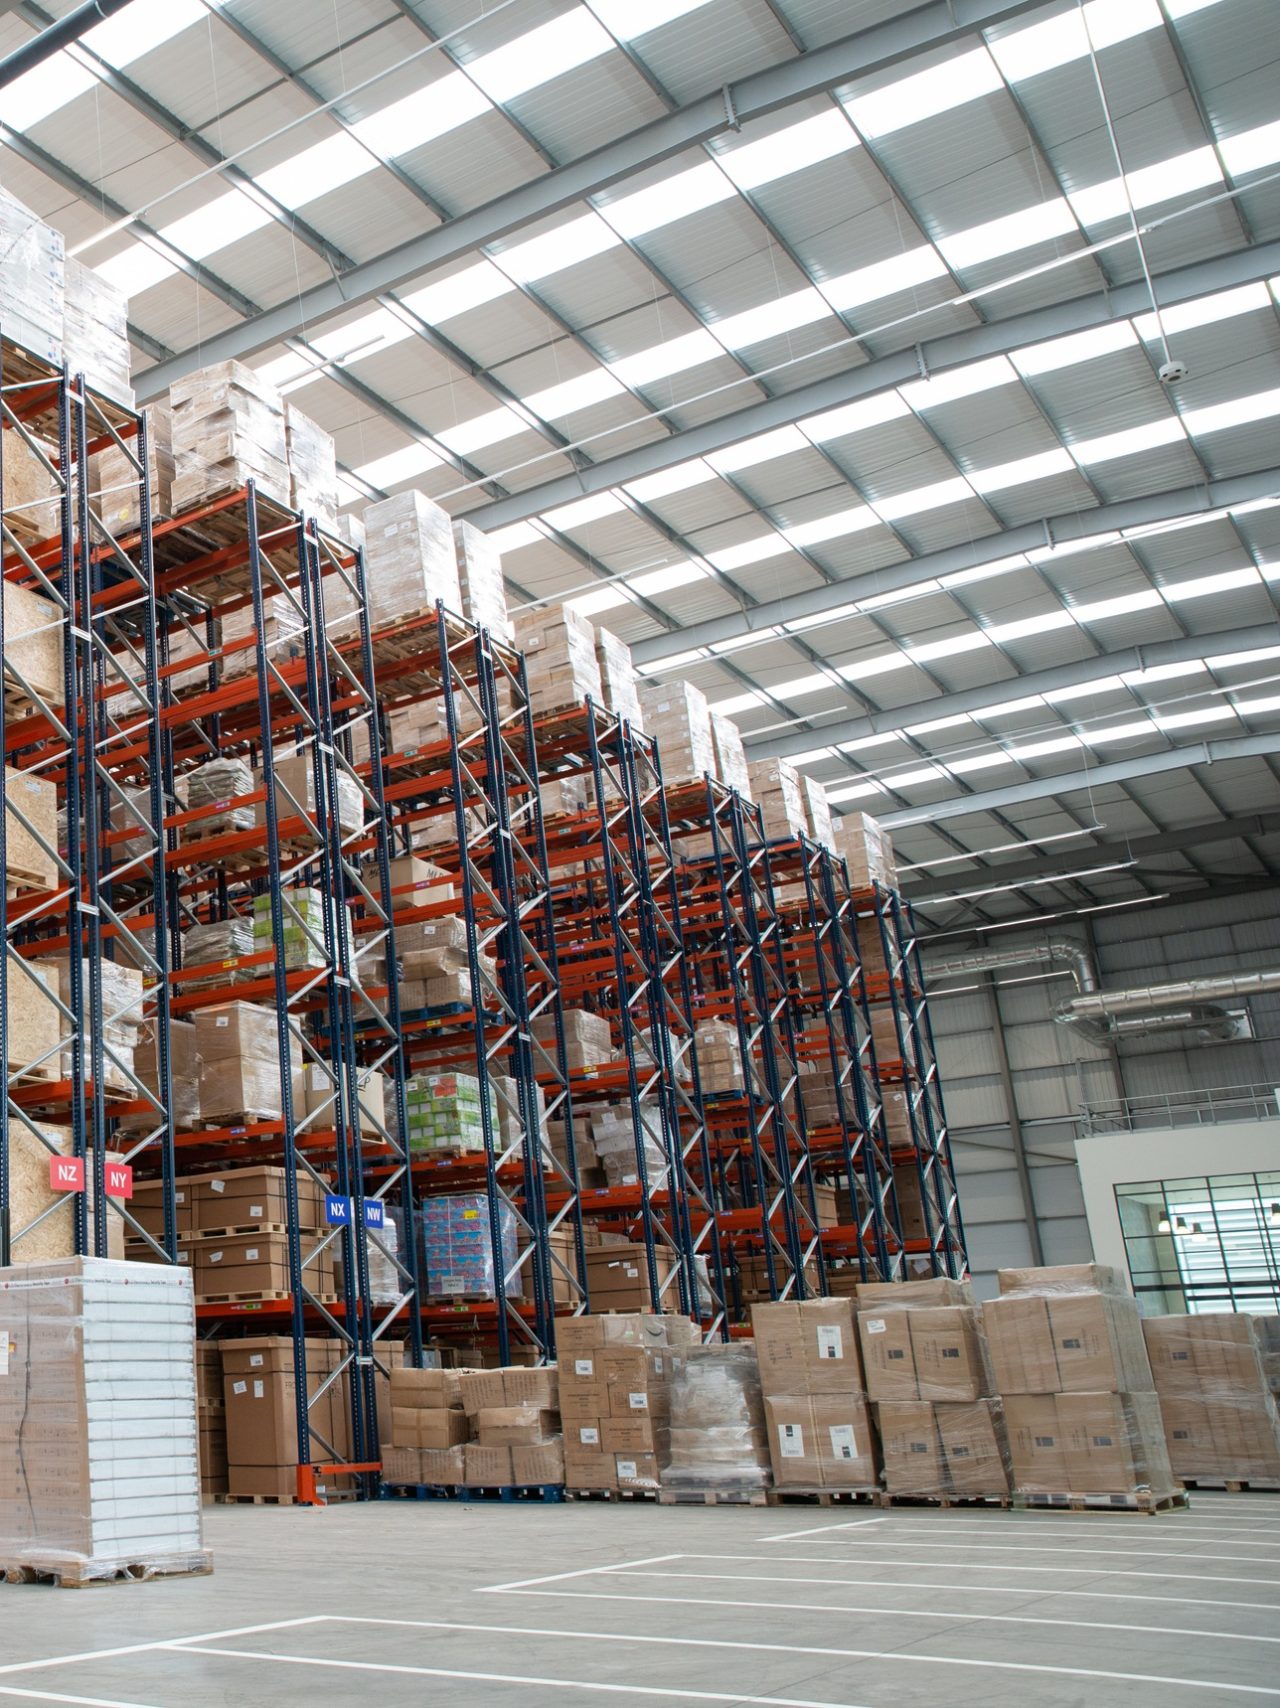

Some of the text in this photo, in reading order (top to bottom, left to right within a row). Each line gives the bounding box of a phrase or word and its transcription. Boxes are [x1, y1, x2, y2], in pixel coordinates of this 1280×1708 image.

[58, 1164, 78, 1182] NZ
[110, 1171, 127, 1189] NY
[330, 1202, 346, 1217] NX
[366, 1206, 381, 1222] NW
